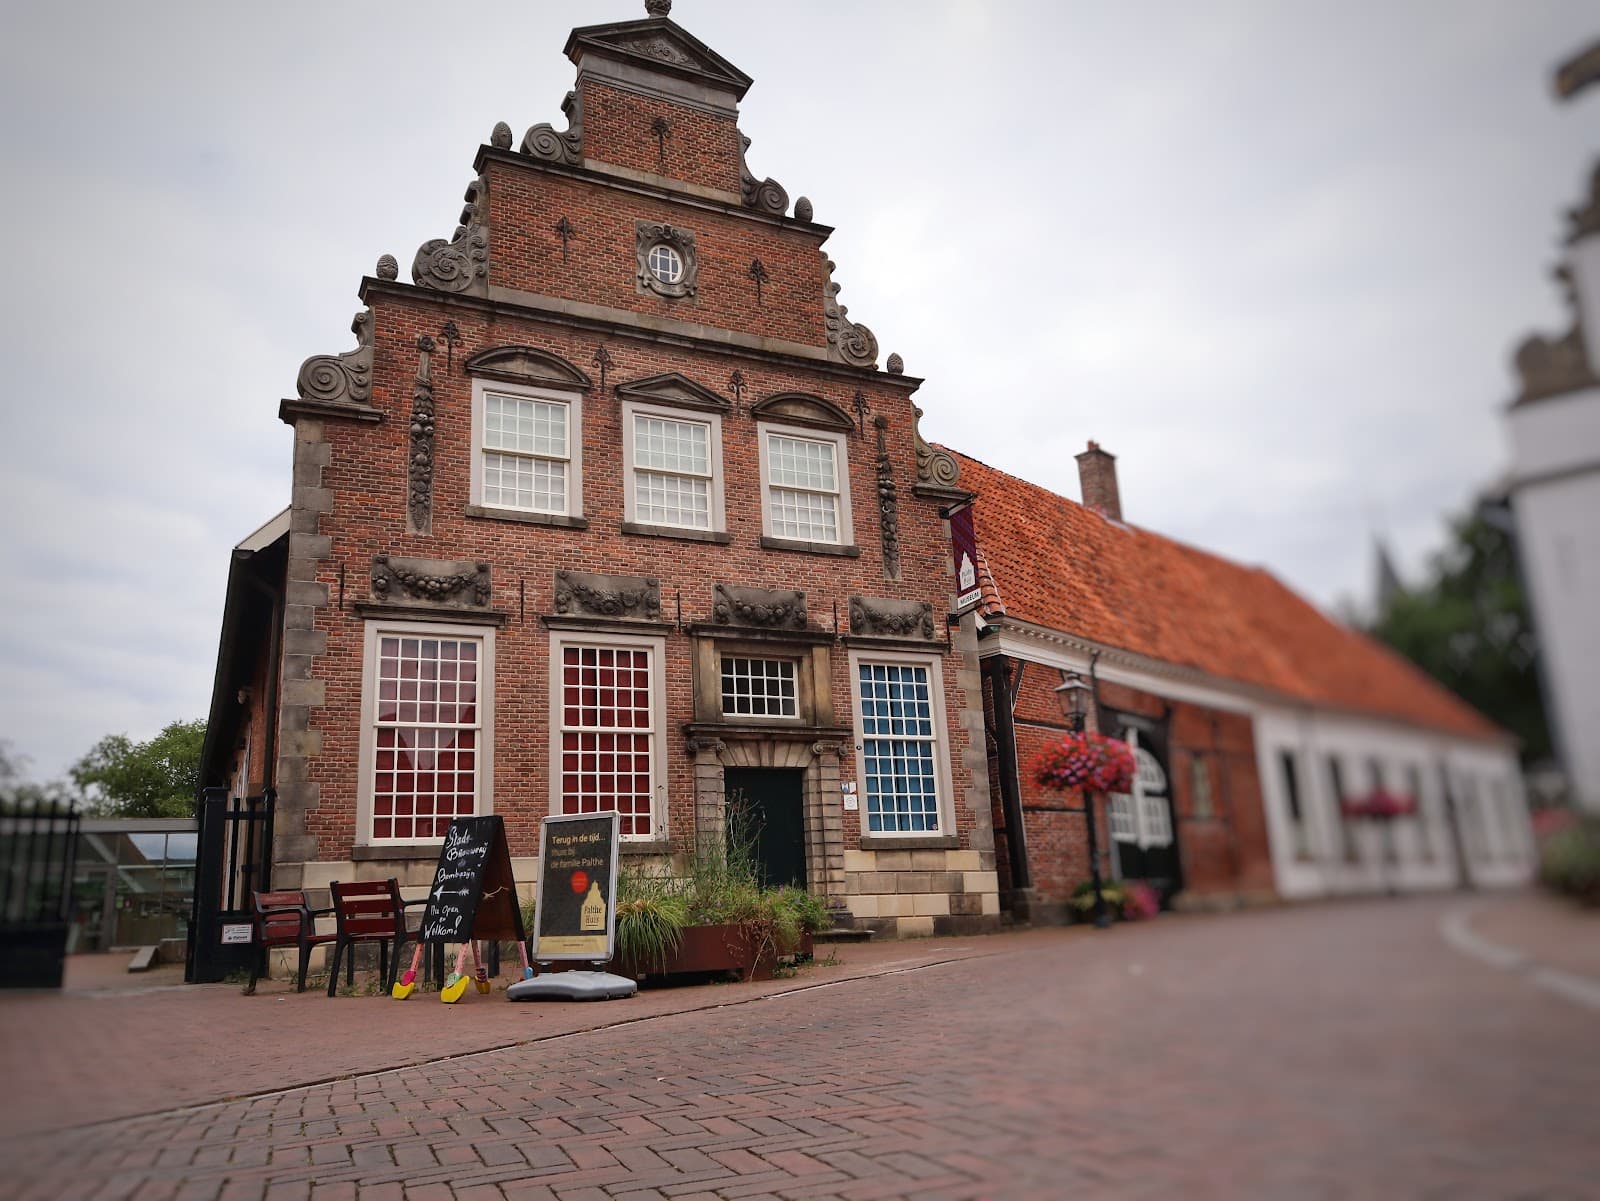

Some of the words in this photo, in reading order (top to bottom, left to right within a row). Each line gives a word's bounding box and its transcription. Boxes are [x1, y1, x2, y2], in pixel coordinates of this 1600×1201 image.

[960, 591, 979, 605] MUSEUM
[552, 836, 571, 845] Terug
[572, 835, 578, 844] in
[579, 834, 588, 842] de
[582, 857, 604, 867] Palthe
